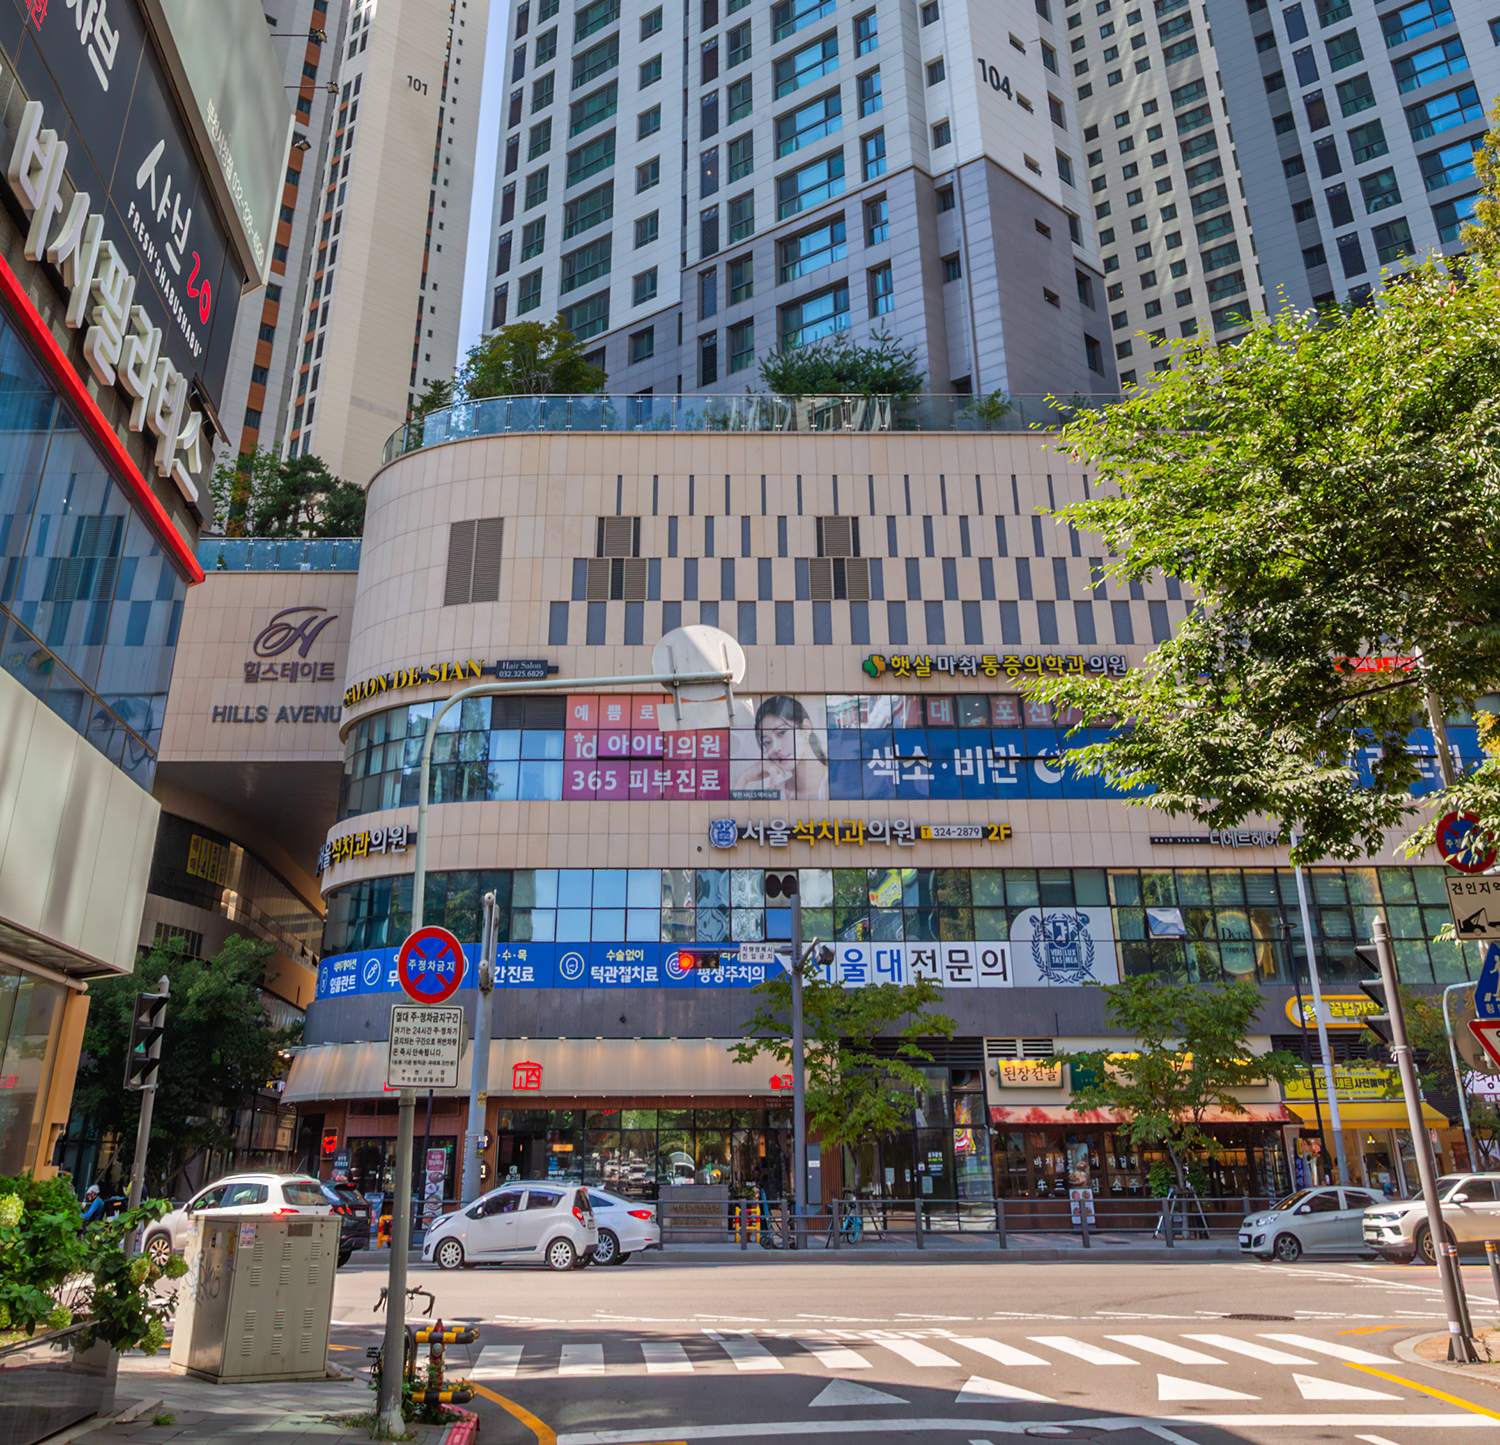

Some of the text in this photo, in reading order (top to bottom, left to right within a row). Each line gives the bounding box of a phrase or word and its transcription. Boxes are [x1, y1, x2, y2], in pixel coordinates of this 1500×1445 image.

[407, 75, 427, 95] 101
[977, 58, 1013, 101] 104
[187, 251, 211, 324] 20
[244, 661, 335, 683] 힐스테이트
[499, 670, 544, 678] 032.325.6829
[343, 659, 484, 707] SALON DE SIAN
[212, 705, 342, 723] HILLS AVENU
[607, 734, 721, 758] 아이디의원
[572, 769, 721, 793] 365 피부진료
[741, 818, 917, 847] 서울석치과의원
[933, 827, 980, 838] 324-2879
[987, 823, 1011, 841] 2F
[606, 949, 644, 962] 수술없이
[408, 959, 455, 972] 주정차금지
[493, 966, 534, 984] 간진료
[590, 966, 659, 984] 턱관절치료
[330, 975, 356, 994] 임플란트
[396, 1012, 409, 1022] 절대
[394, 1026, 411, 1034] 여기는
[412, 1026, 432, 1034] 24시간
[415, 1037, 436, 1045] 구간으로
[1003, 1066, 1058, 1082] 된장전골
